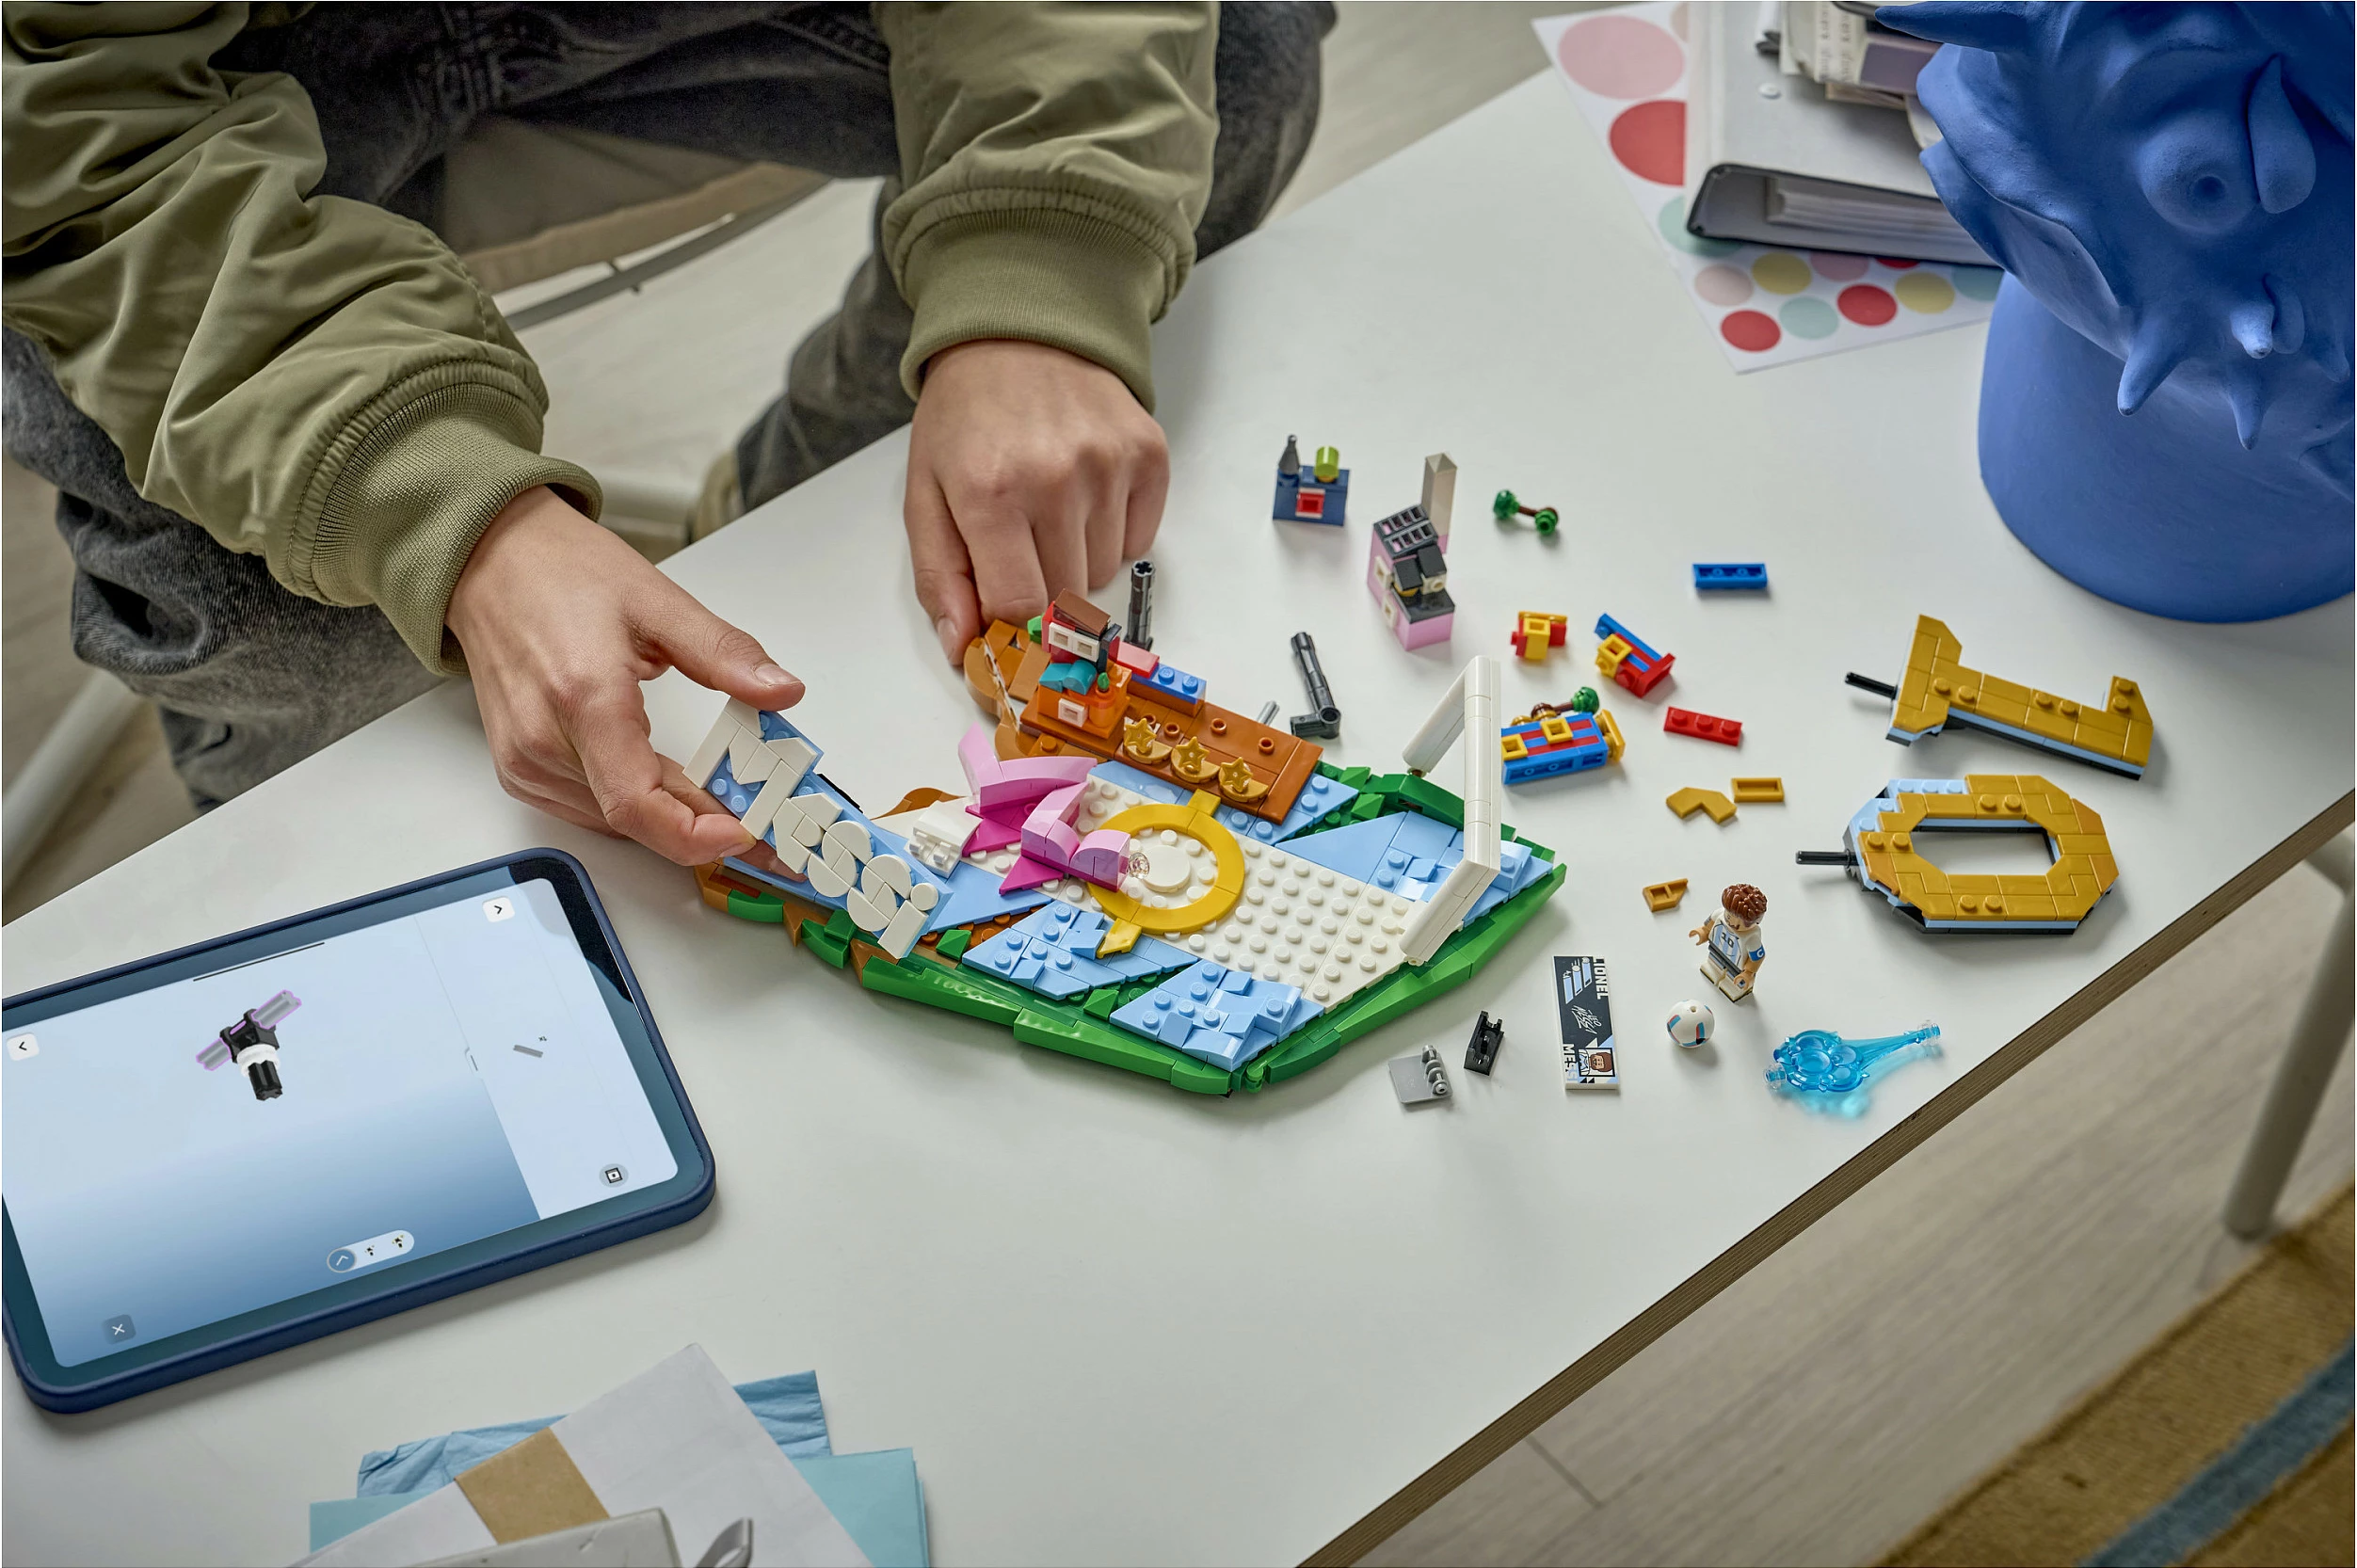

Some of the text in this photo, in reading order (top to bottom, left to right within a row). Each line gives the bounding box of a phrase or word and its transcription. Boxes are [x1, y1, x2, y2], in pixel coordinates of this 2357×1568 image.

[682, 696, 939, 959] Messi
[1721, 932, 1735, 949] 10
[1756, 946, 1765, 958] C
[1593, 957, 1610, 1000] LIONEL
[1563, 1043, 1579, 1084] MESSI
